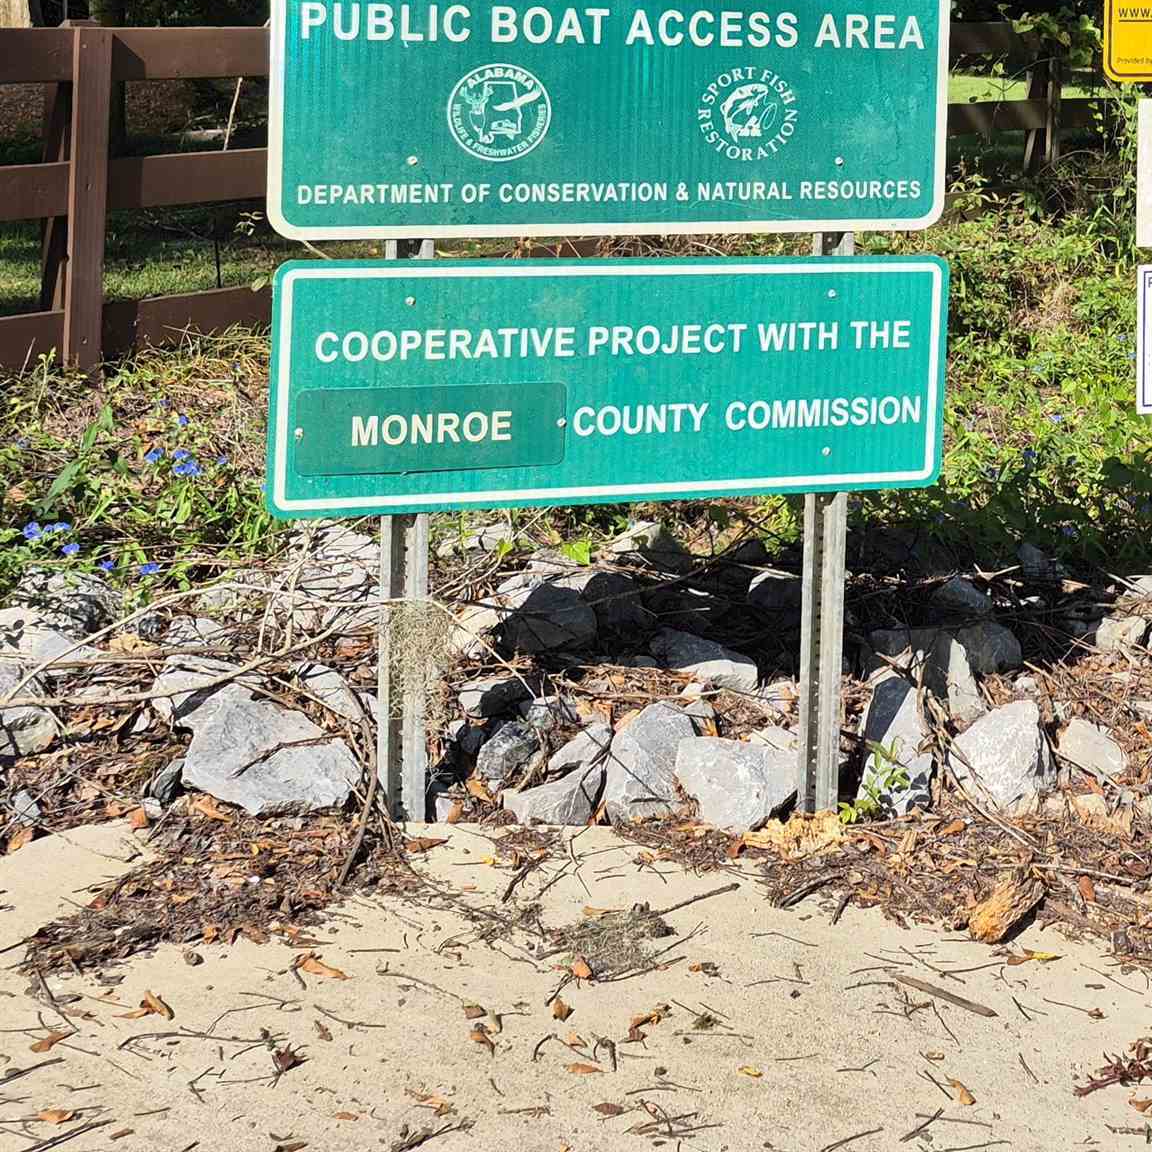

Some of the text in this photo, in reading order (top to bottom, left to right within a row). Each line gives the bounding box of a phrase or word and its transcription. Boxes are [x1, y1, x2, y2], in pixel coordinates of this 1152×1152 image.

[300, 4, 925, 50] PUBLIC BOAT ACCESS AREA
[467, 68, 535, 90] ALABAMA
[702, 67, 796, 105] SPORT FISH
[698, 108, 798, 161] RESTORATION
[297, 179, 922, 205] DEPARTMENT OF CONSERVATION & NATURAL RESOURCES
[315, 320, 911, 362] COOPERATIVE PROJECT WITH THE
[351, 395, 922, 447] MONROE COUNTY COMMISSION
